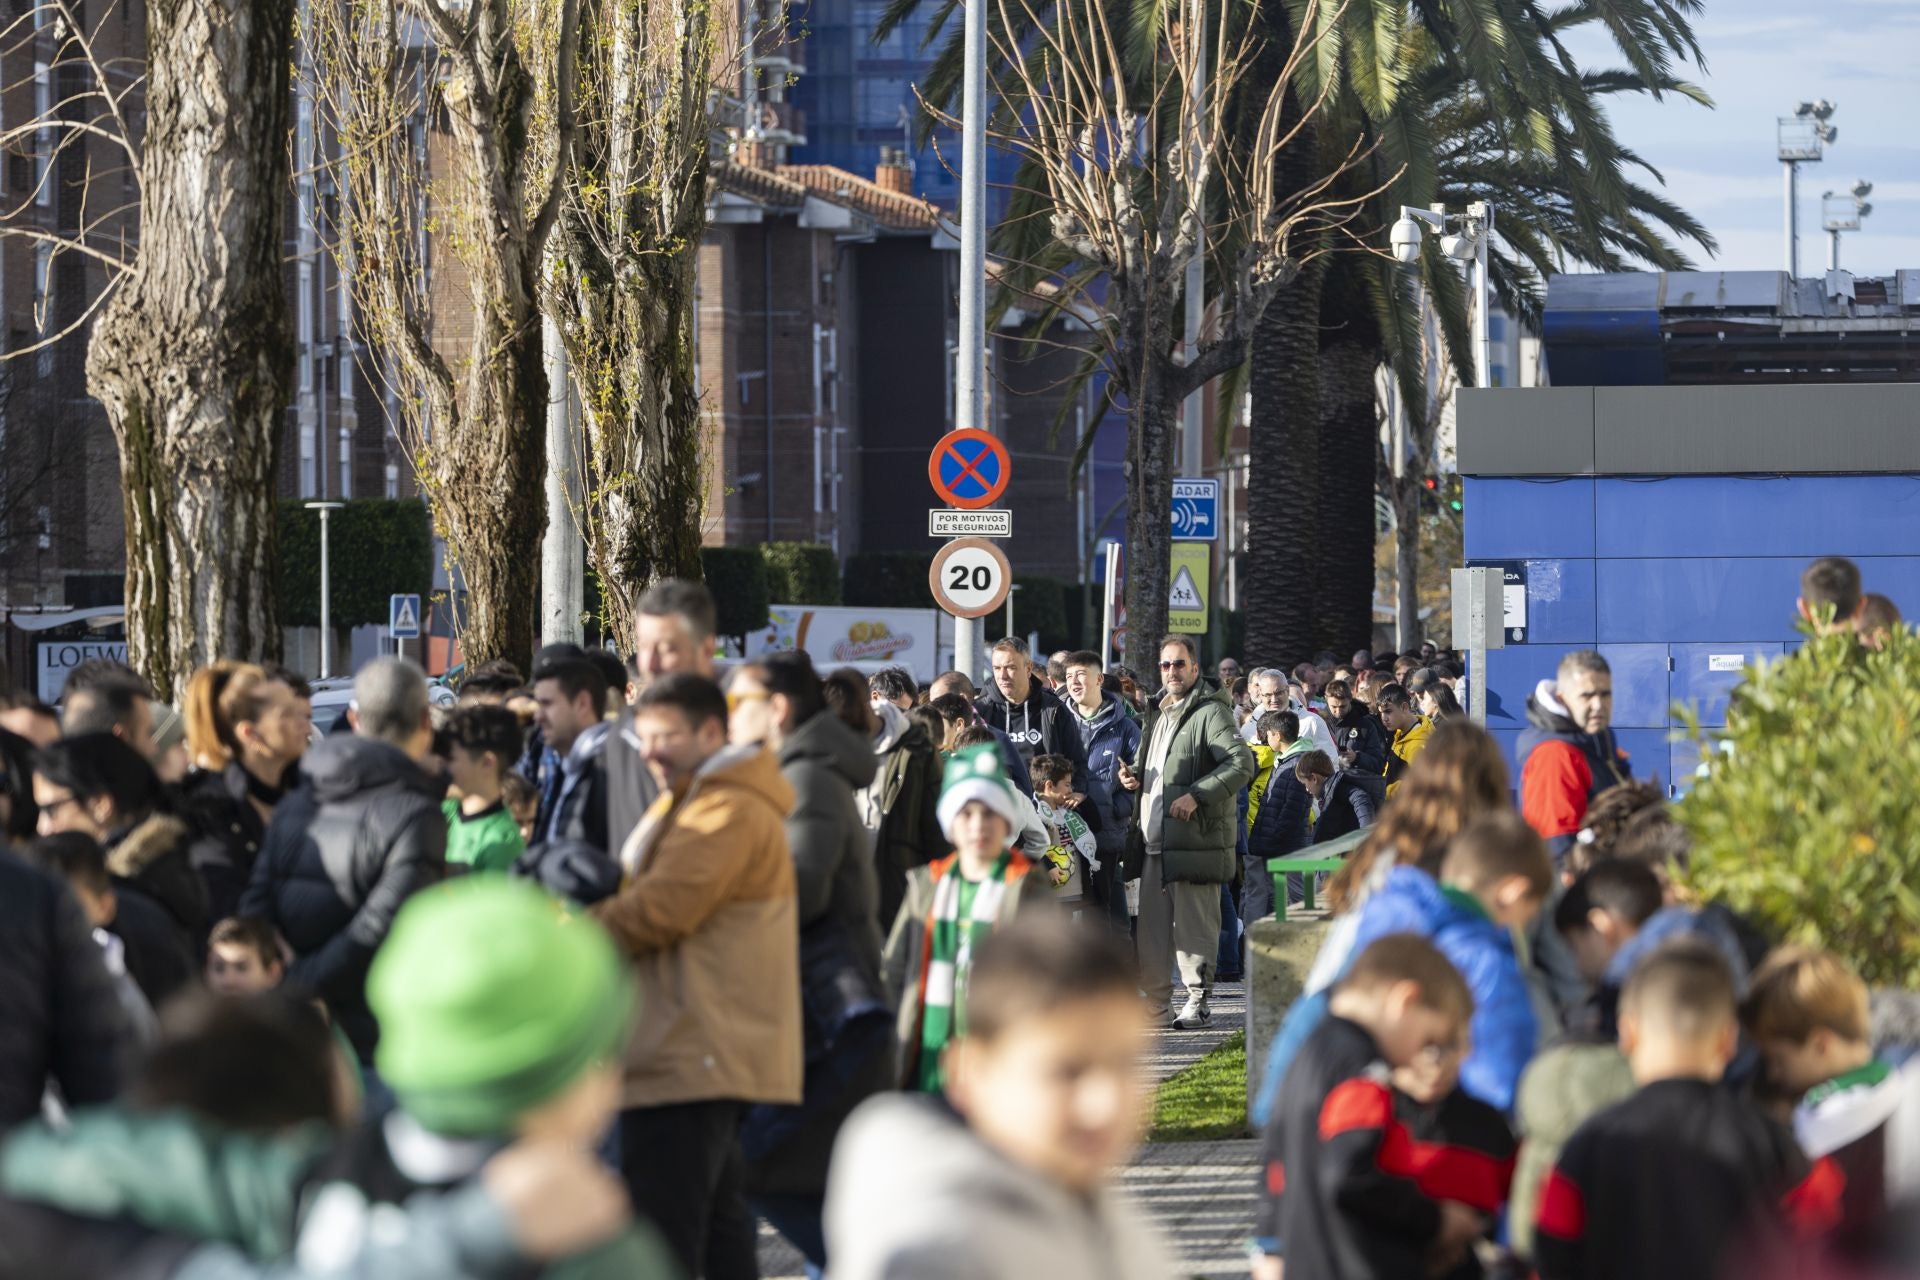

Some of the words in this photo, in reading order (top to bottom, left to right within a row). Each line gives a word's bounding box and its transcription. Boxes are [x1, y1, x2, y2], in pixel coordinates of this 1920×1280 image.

[1175, 486, 1210, 496] ADAR
[961, 515, 1004, 523] MOTIVOS
[949, 565, 991, 591] 20
[1168, 617, 1202, 627] OLEGIO
